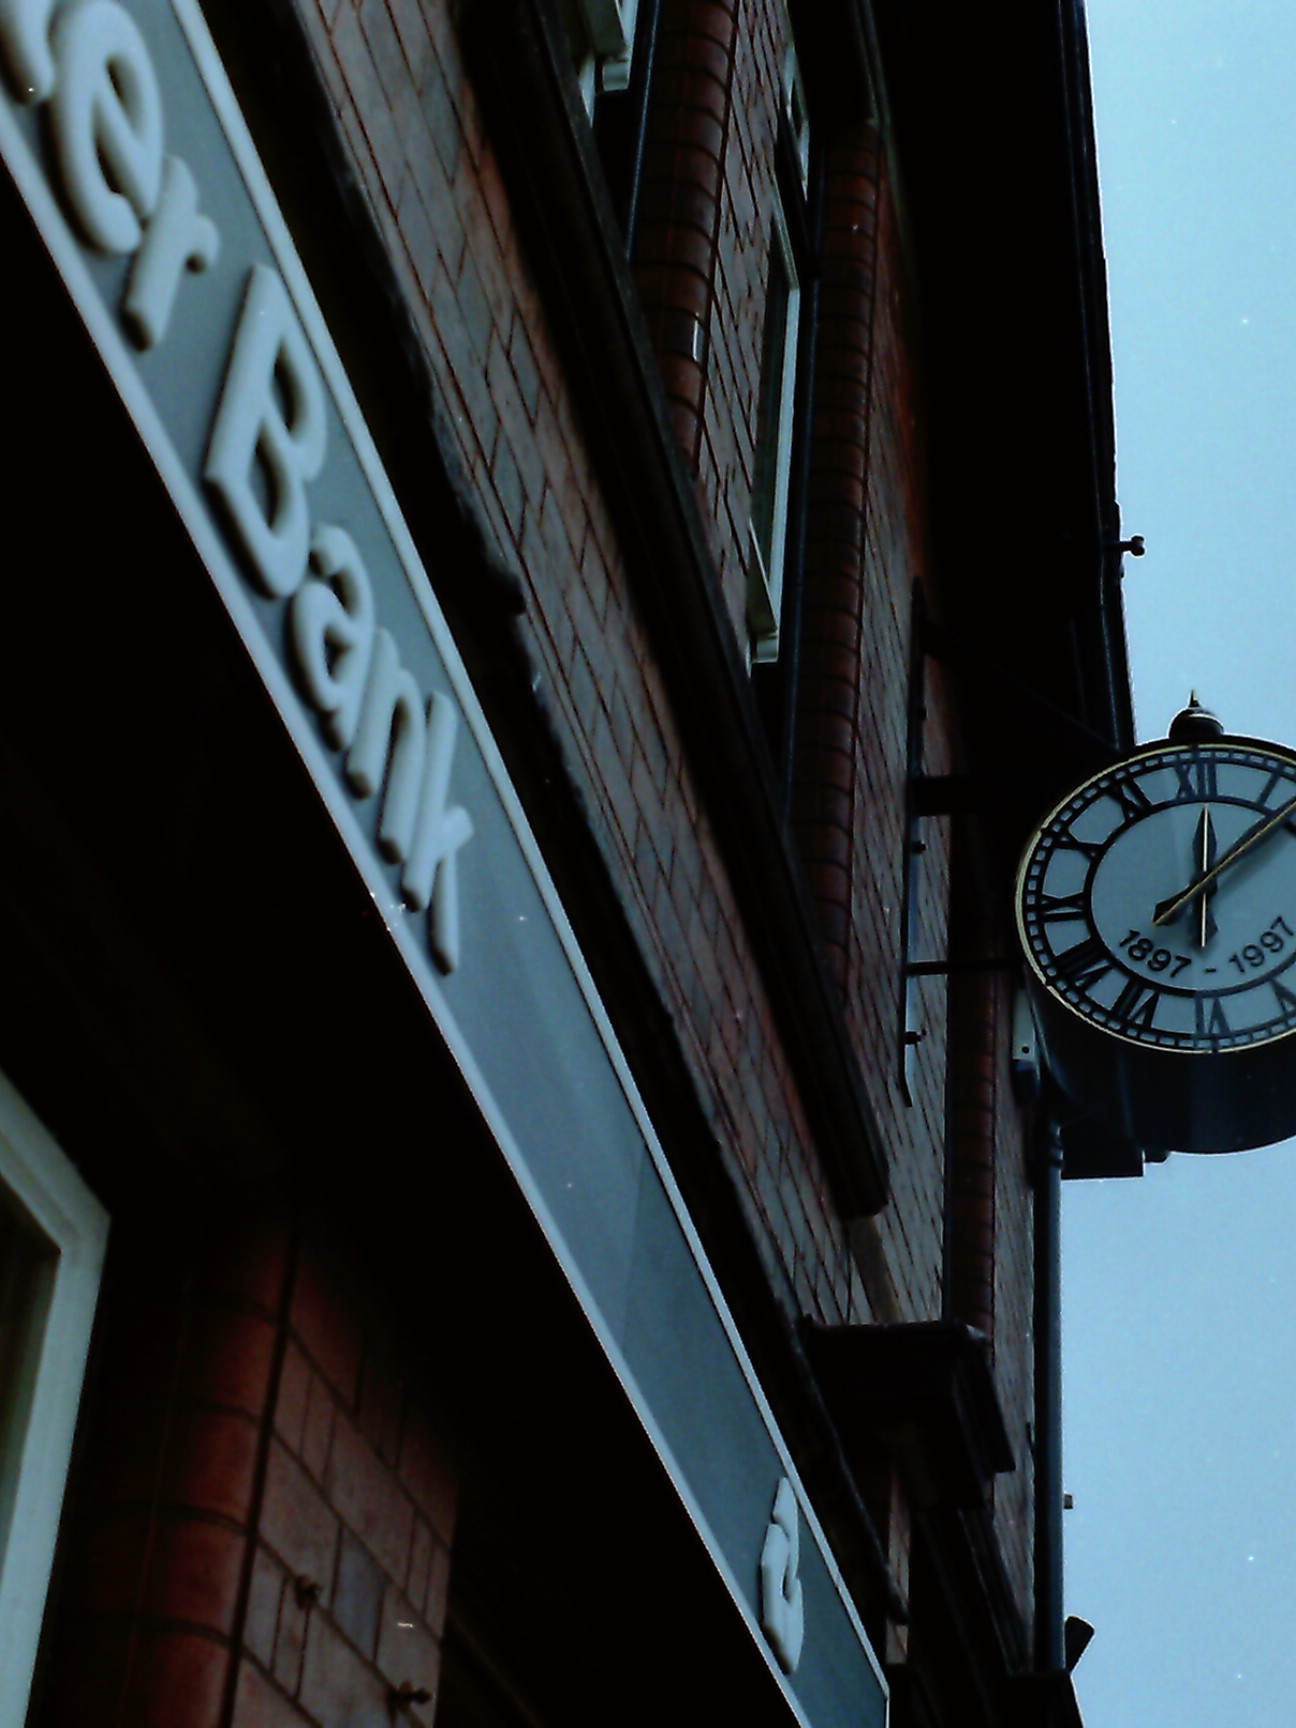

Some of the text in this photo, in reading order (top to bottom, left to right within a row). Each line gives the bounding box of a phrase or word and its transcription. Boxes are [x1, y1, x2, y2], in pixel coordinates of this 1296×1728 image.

[0, 0, 474, 975] er Bank
[1119, 929, 1192, 978] 1897
[1228, 915, 1295, 974] 1997
